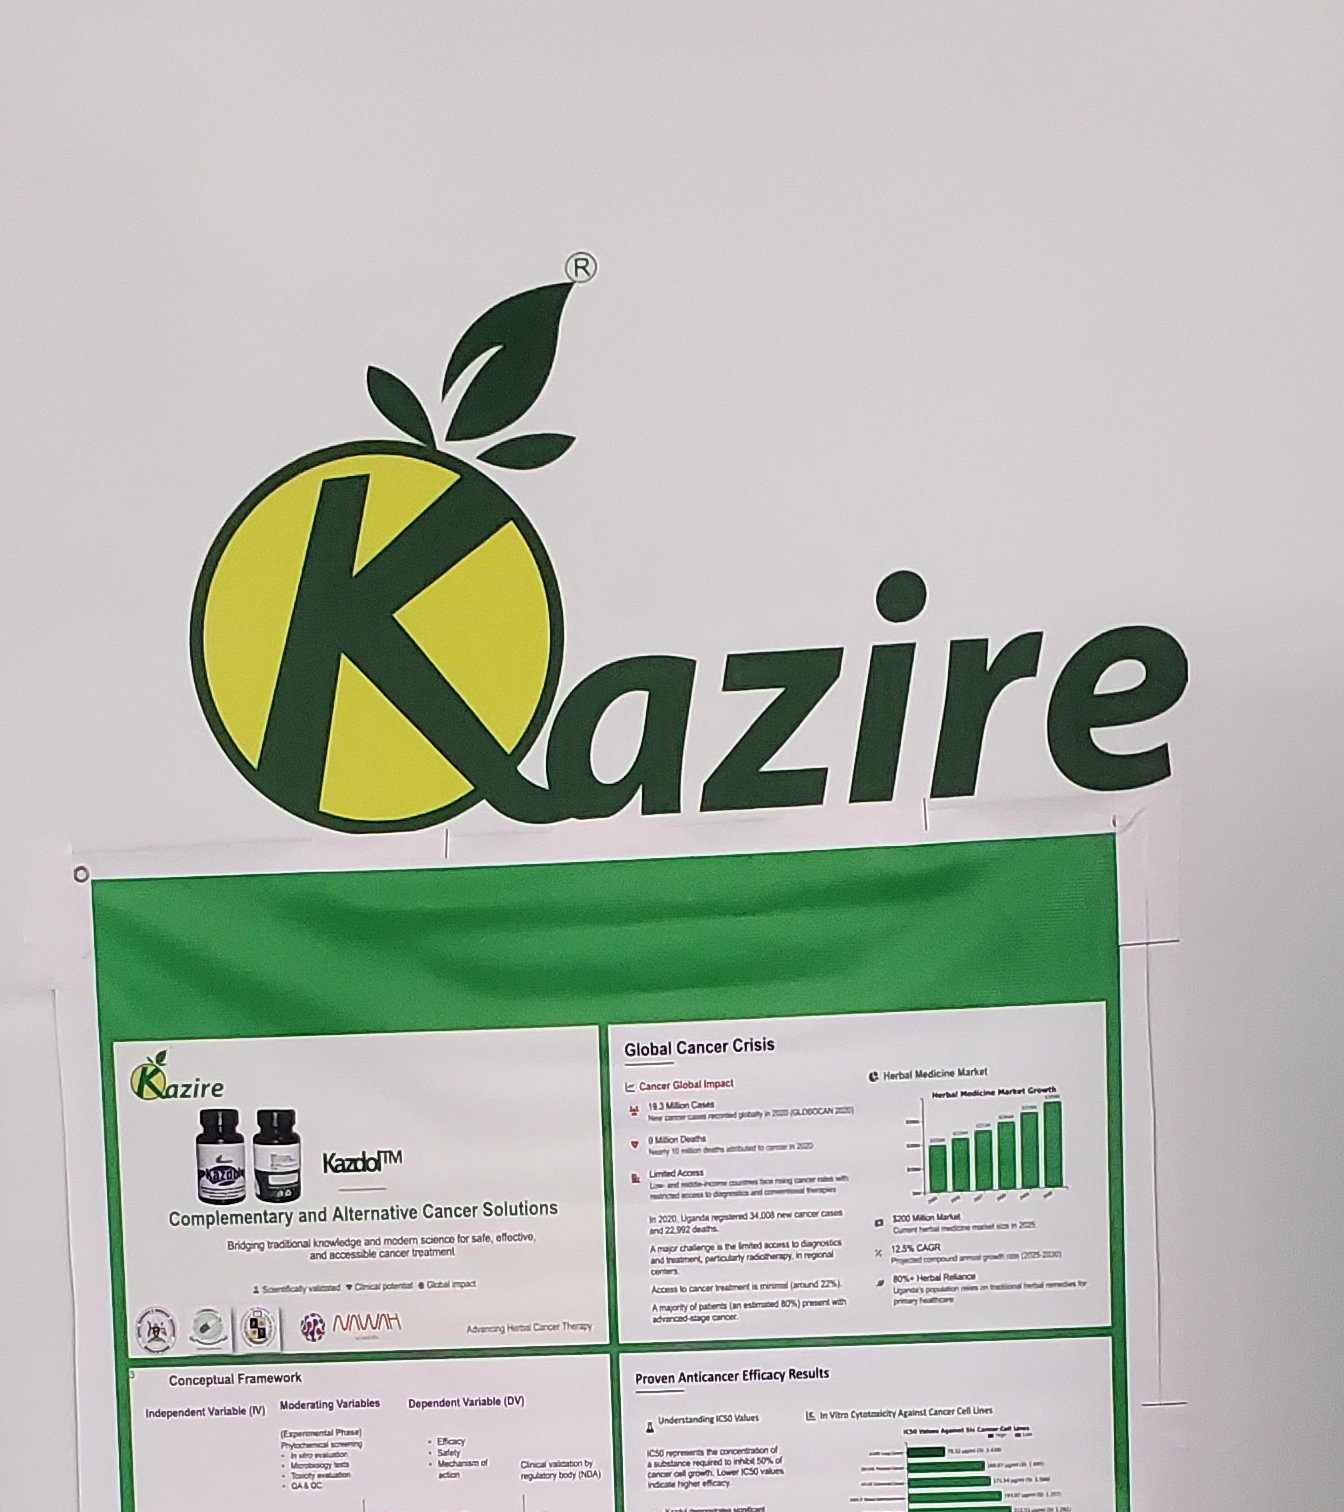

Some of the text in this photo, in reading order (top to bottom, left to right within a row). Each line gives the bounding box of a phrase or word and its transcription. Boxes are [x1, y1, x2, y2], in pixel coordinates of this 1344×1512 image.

[189, 439, 1188, 834] Kazire
[624, 1037, 774, 1057] Global Cancer Crisis
[130, 1063, 224, 1100] Kazire
[883, 1067, 988, 1081] Herbal Medicine Market
[639, 1077, 735, 1092] Cancer Global Impact
[170, 1200, 557, 1229] Complementary and Alternative Cancer Solutions
[168, 1371, 303, 1388] Conceptual Framework
[635, 1366, 830, 1385] Proven Anticancer Efficacy Results
[145, 1407, 206, 1420] Independent
[207, 1405, 247, 1417] Variable
